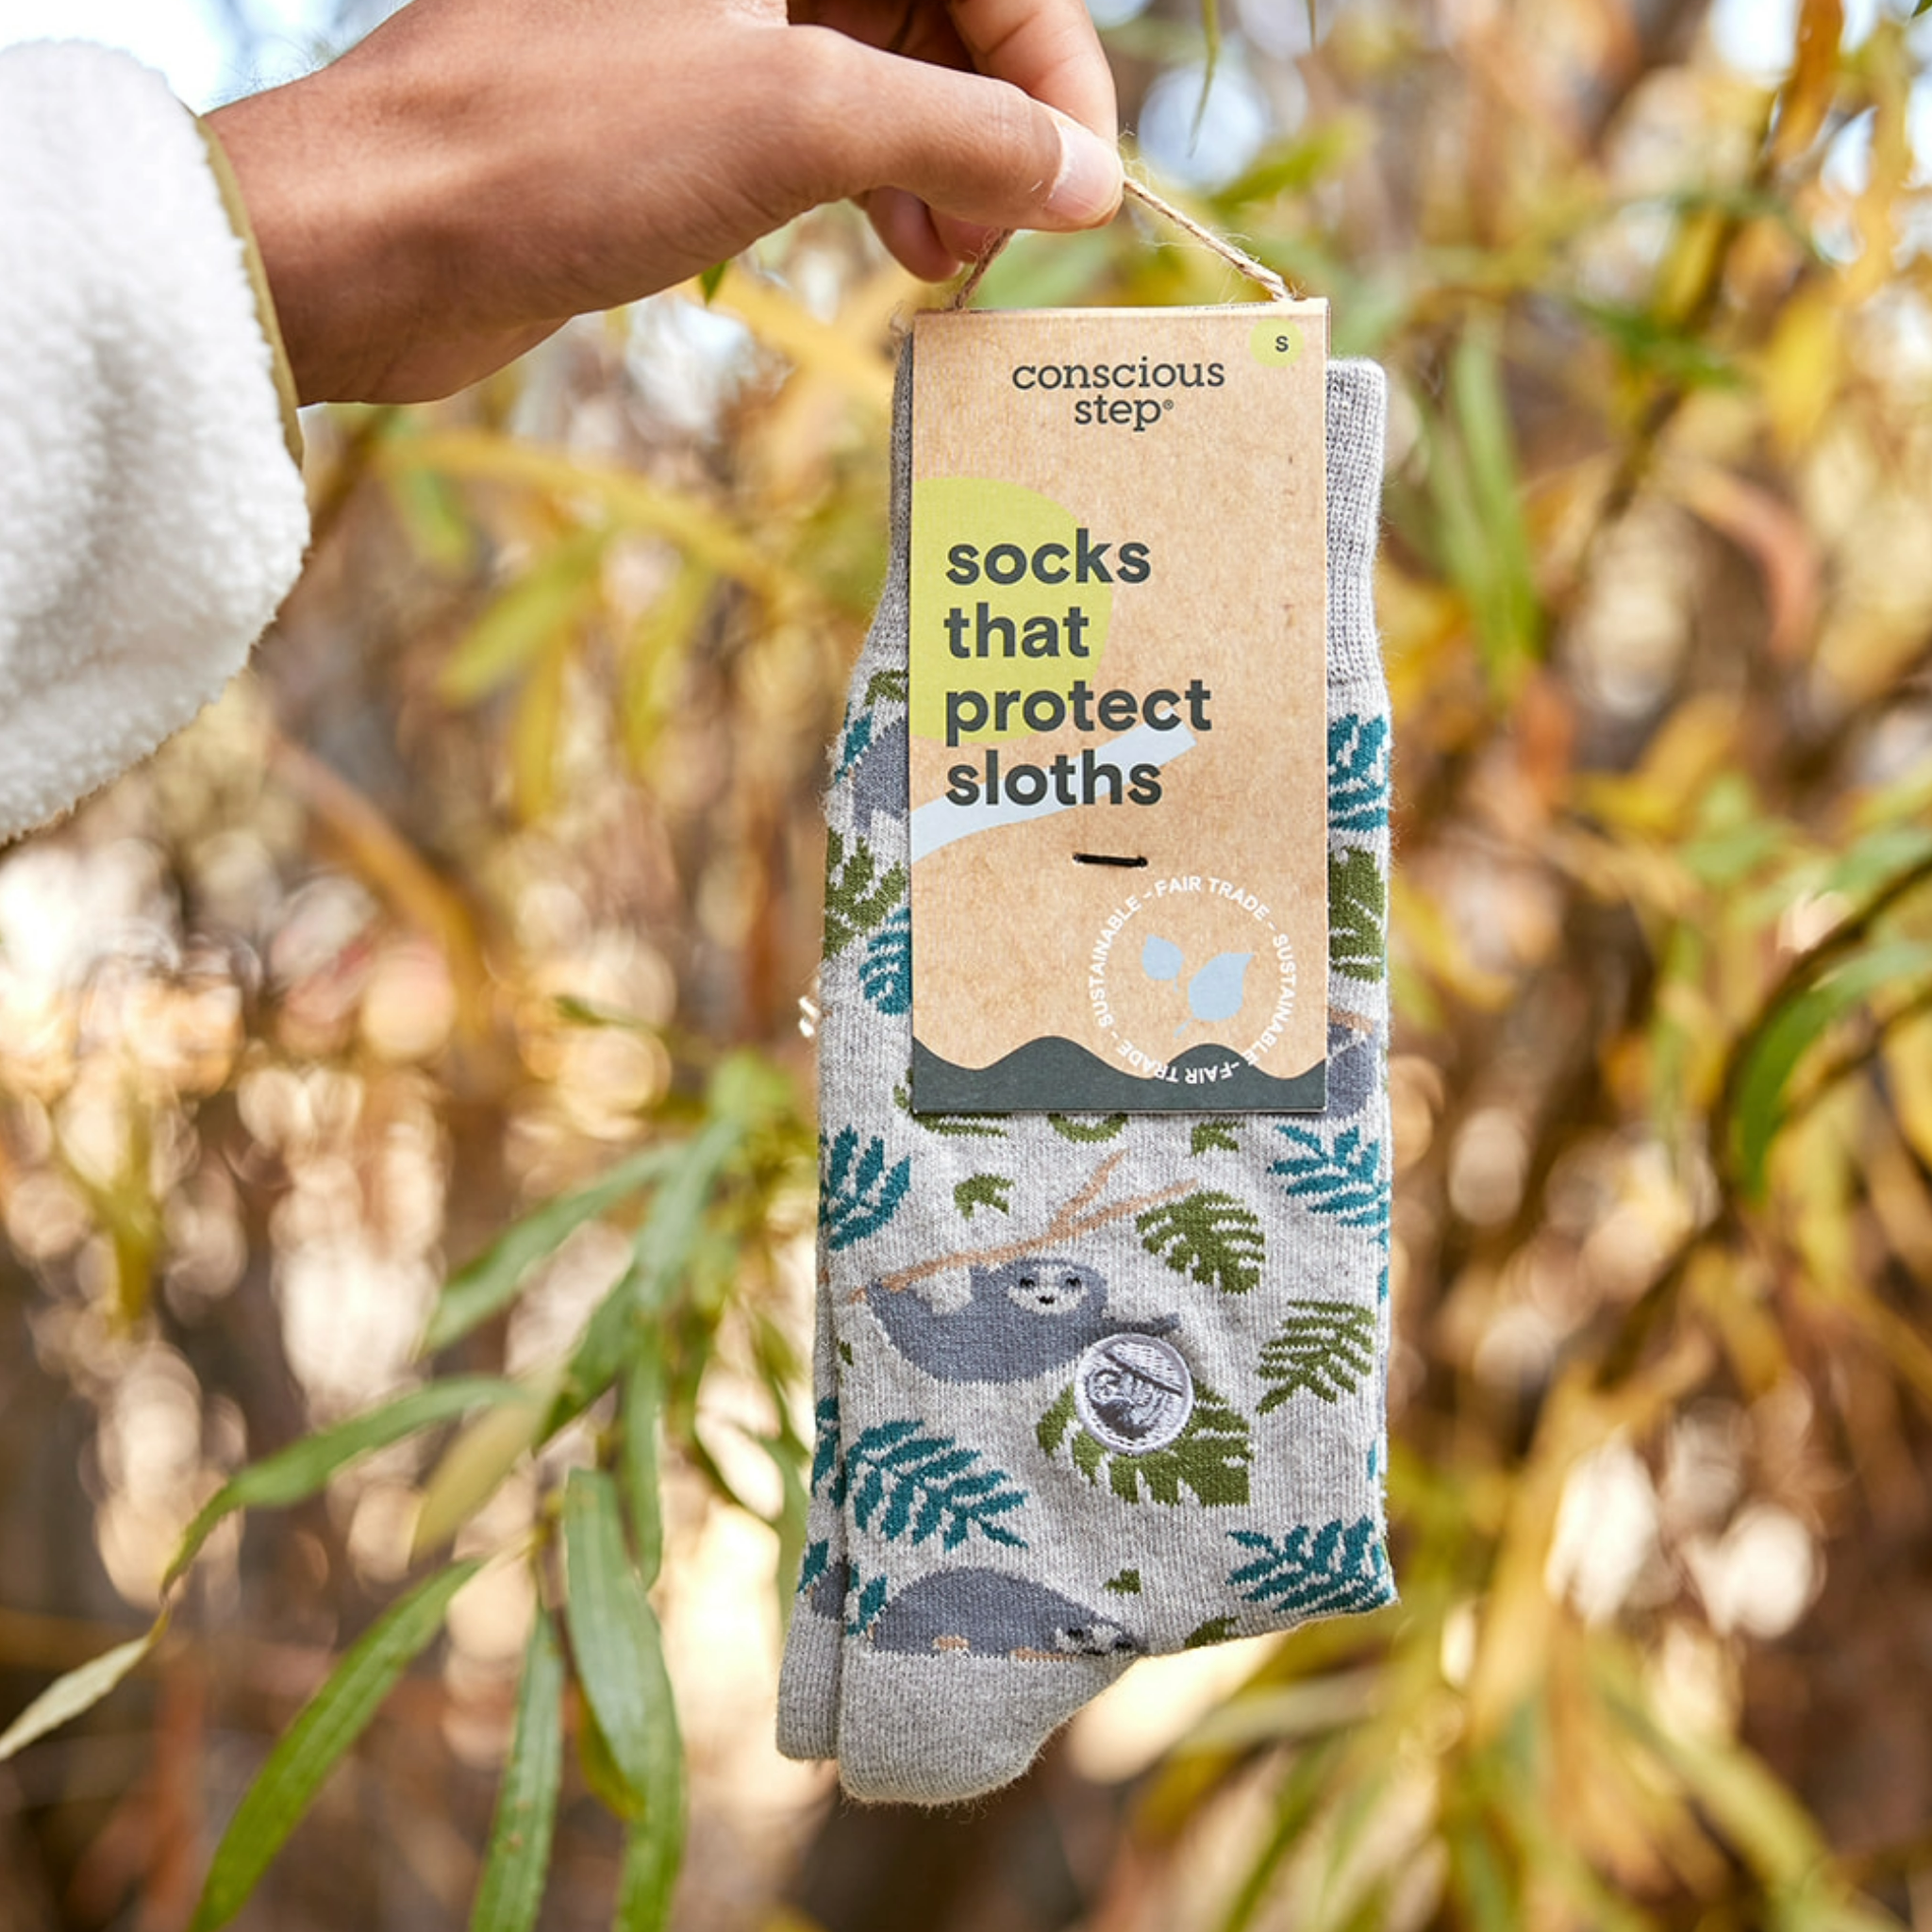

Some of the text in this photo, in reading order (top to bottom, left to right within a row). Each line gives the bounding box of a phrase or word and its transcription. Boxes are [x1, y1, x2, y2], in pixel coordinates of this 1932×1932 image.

[1012, 356, 1225, 390] conscious
[945, 527, 1152, 586] socks
[943, 602, 1091, 658] that
[945, 679, 1213, 747] protect
[945, 749, 1162, 807] sloths
[1154, 875, 1203, 897] FAIR
[1208, 876, 1270, 922] TRADE
[1088, 894, 1142, 1028] SUSTAINABLE
[1241, 933, 1297, 1067] SUSTAINABLE
[1116, 1039, 1179, 1083] TRADE
